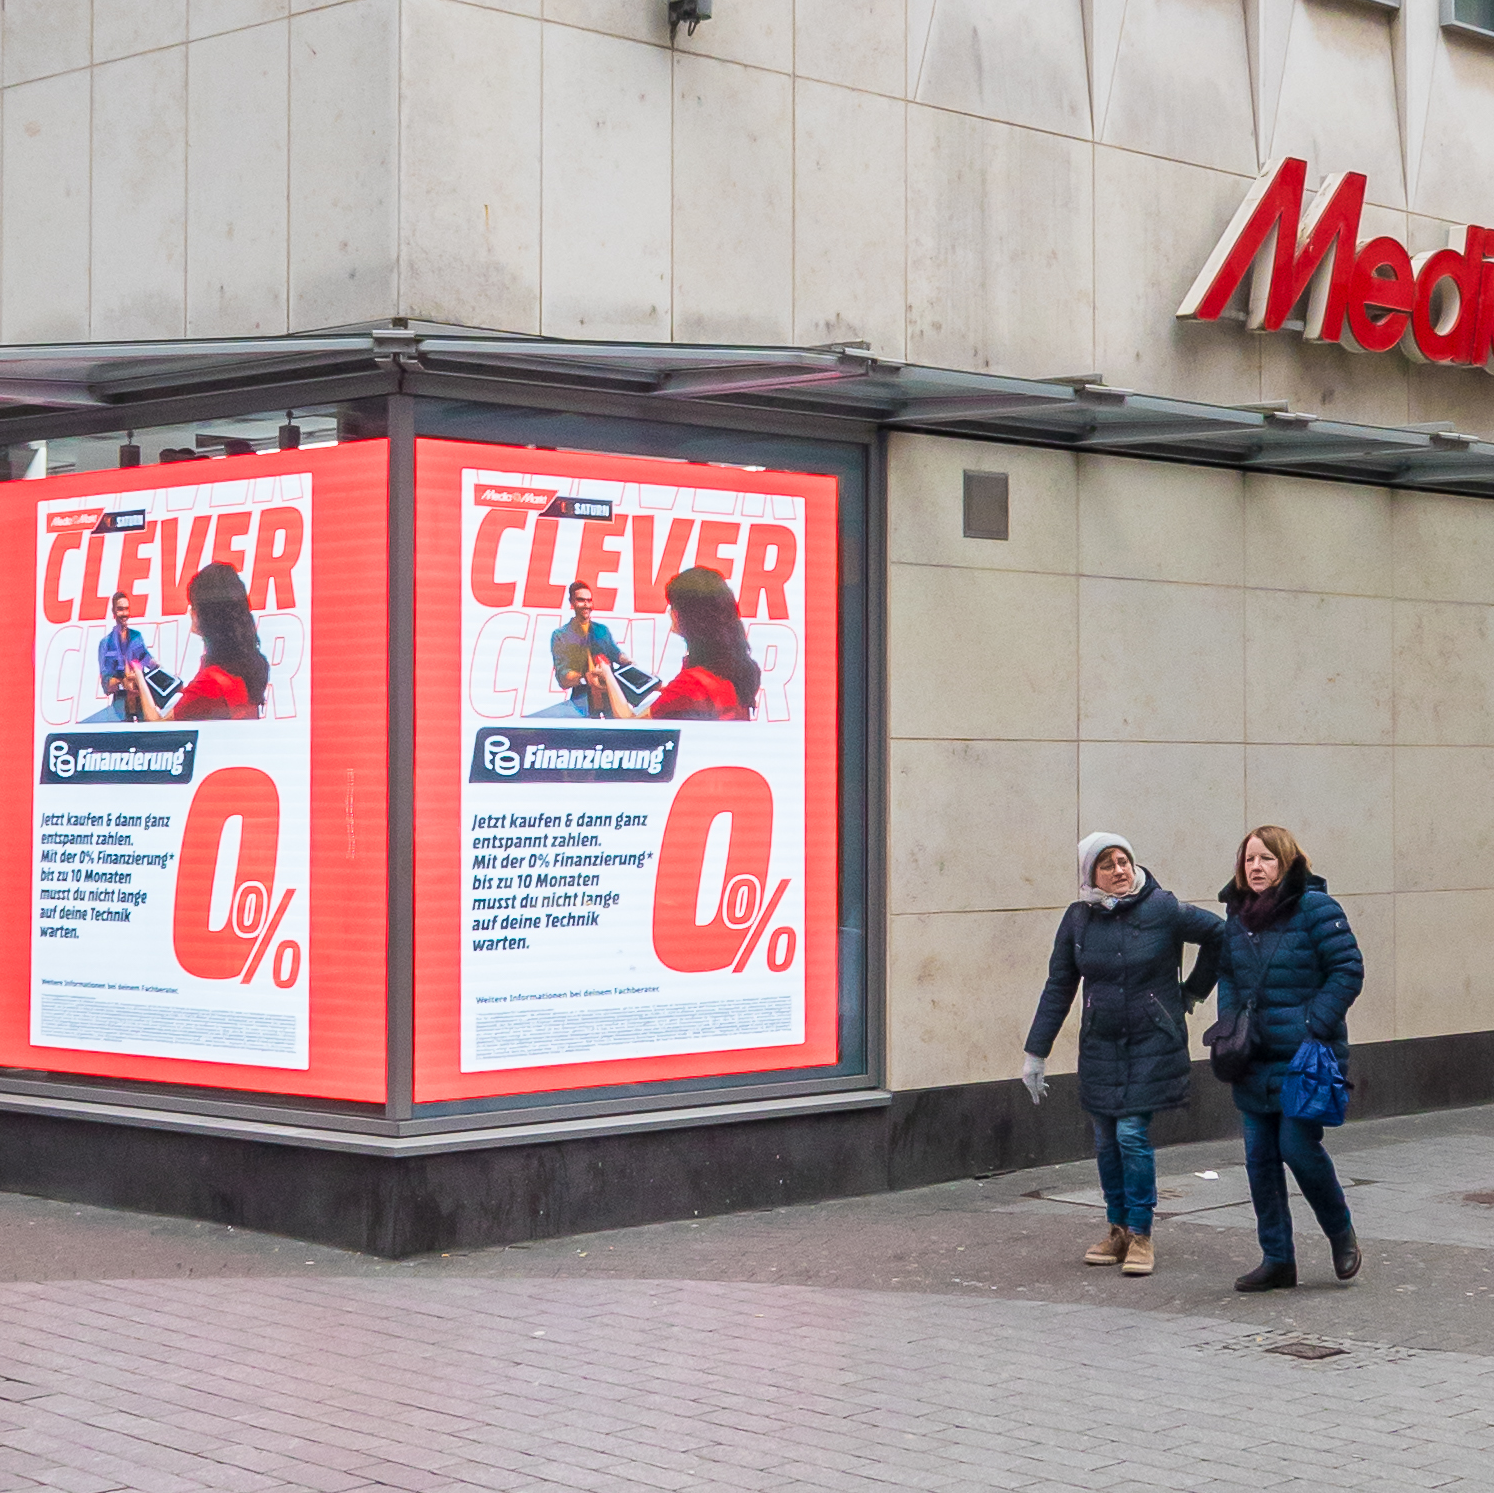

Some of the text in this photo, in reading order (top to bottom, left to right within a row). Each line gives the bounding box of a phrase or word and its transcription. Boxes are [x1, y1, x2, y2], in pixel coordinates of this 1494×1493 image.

[43, 506, 304, 623] CLEVER
[471, 509, 797, 620] CLEVER
[40, 812, 171, 830] Jetzt kaufen & dann ganz
[471, 813, 648, 831] Jetzt kaufen & dann ganz
[41, 832, 133, 847] entspannt zahlen.
[472, 833, 601, 851] entspannt zahlen.
[40, 849, 58, 863] Mit
[60, 850, 77, 863] der
[79, 851, 95, 865] 0%
[472, 855, 497, 870] Mit
[500, 854, 526, 869] der
[529, 854, 550, 868] 0%
[40, 867, 132, 884] bis zu 10 Monaten
[173, 766, 302, 989] 0%
[651, 766, 797, 974] 0%
[472, 873, 600, 890] bis zu 10 Monaten
[40, 887, 147, 907] musst du nicht lange
[472, 891, 620, 910] musst du nicht lange
[39, 905, 132, 922] auf deine Technik
[472, 912, 600, 931] auf deine Technik
[40, 925, 79, 939] warten.
[472, 936, 529, 951] warten.
